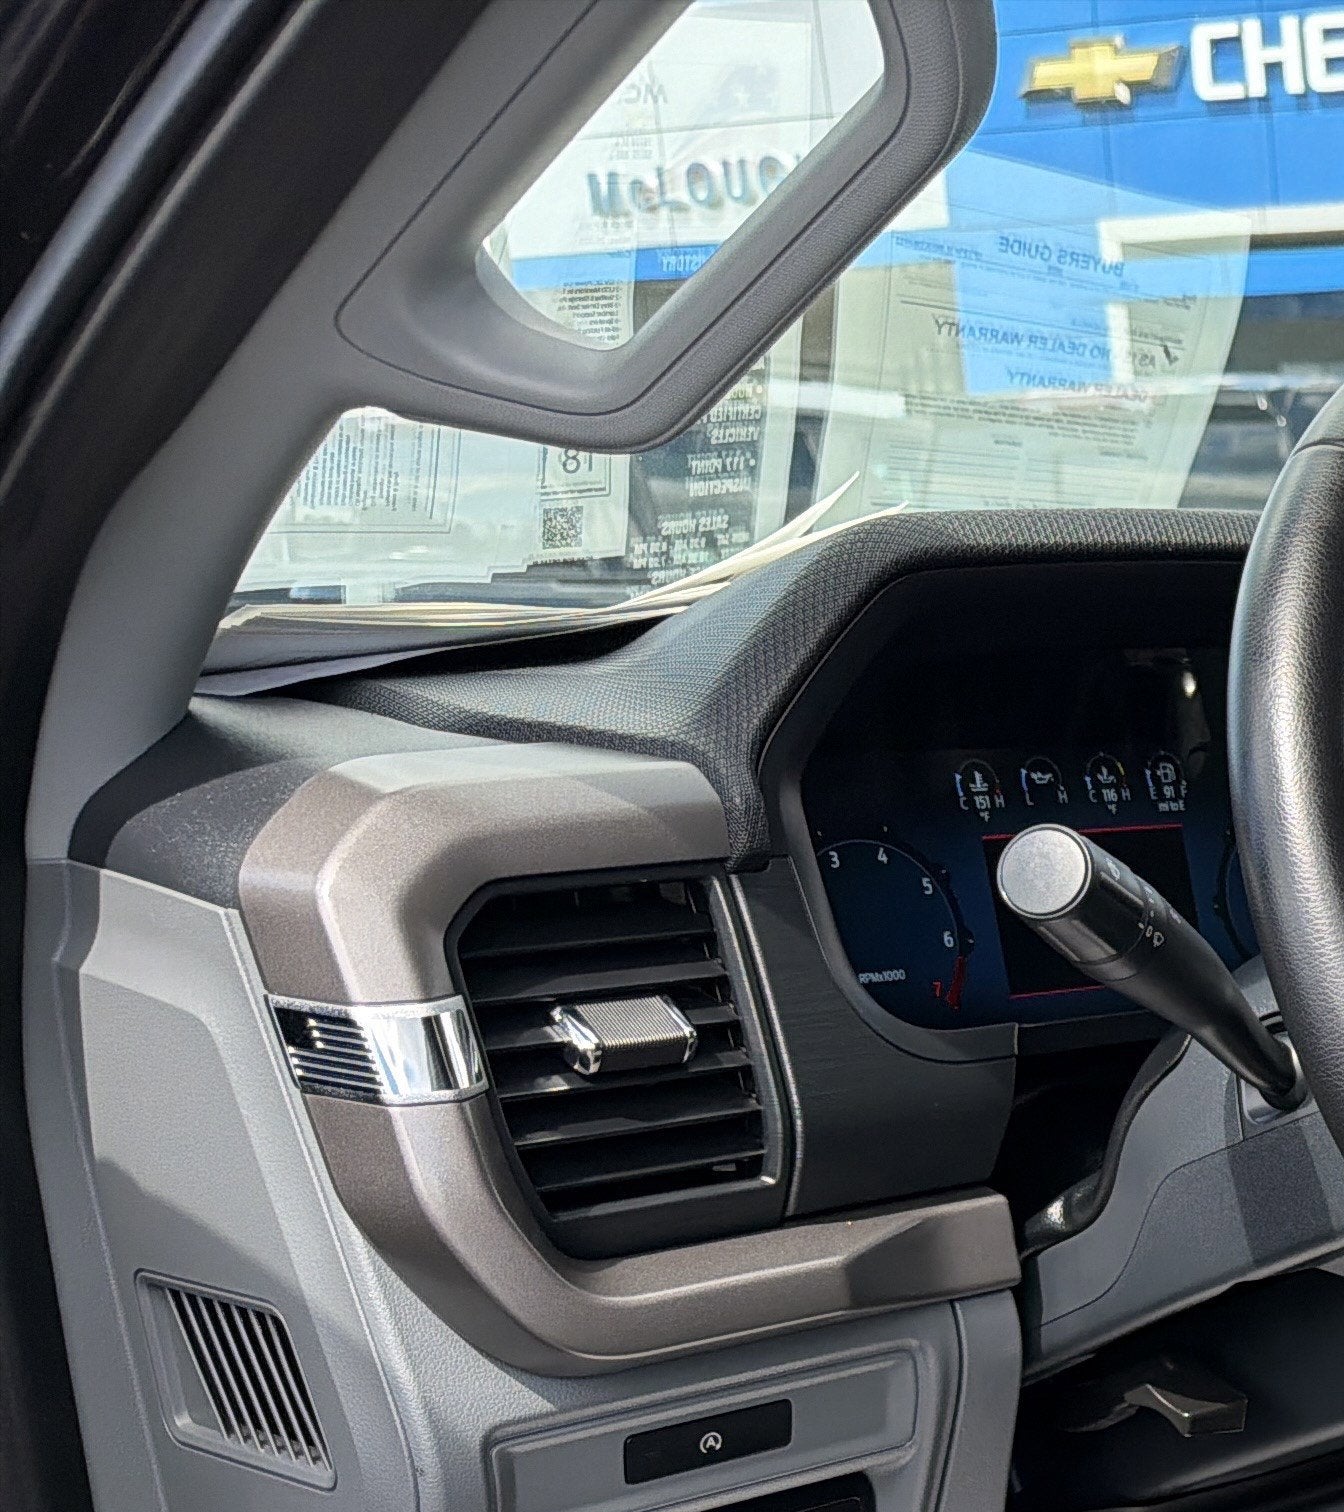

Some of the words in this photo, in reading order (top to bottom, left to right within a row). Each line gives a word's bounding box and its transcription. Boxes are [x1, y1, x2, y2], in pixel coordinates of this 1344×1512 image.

[974, 796, 990, 810] 151
[1102, 788, 1118, 802] 116
[829, 851, 840, 868] 3
[877, 847, 888, 864] 4
[922, 877, 933, 895] 5
[943, 931, 954, 948] 6
[932, 982, 941, 997] 7
